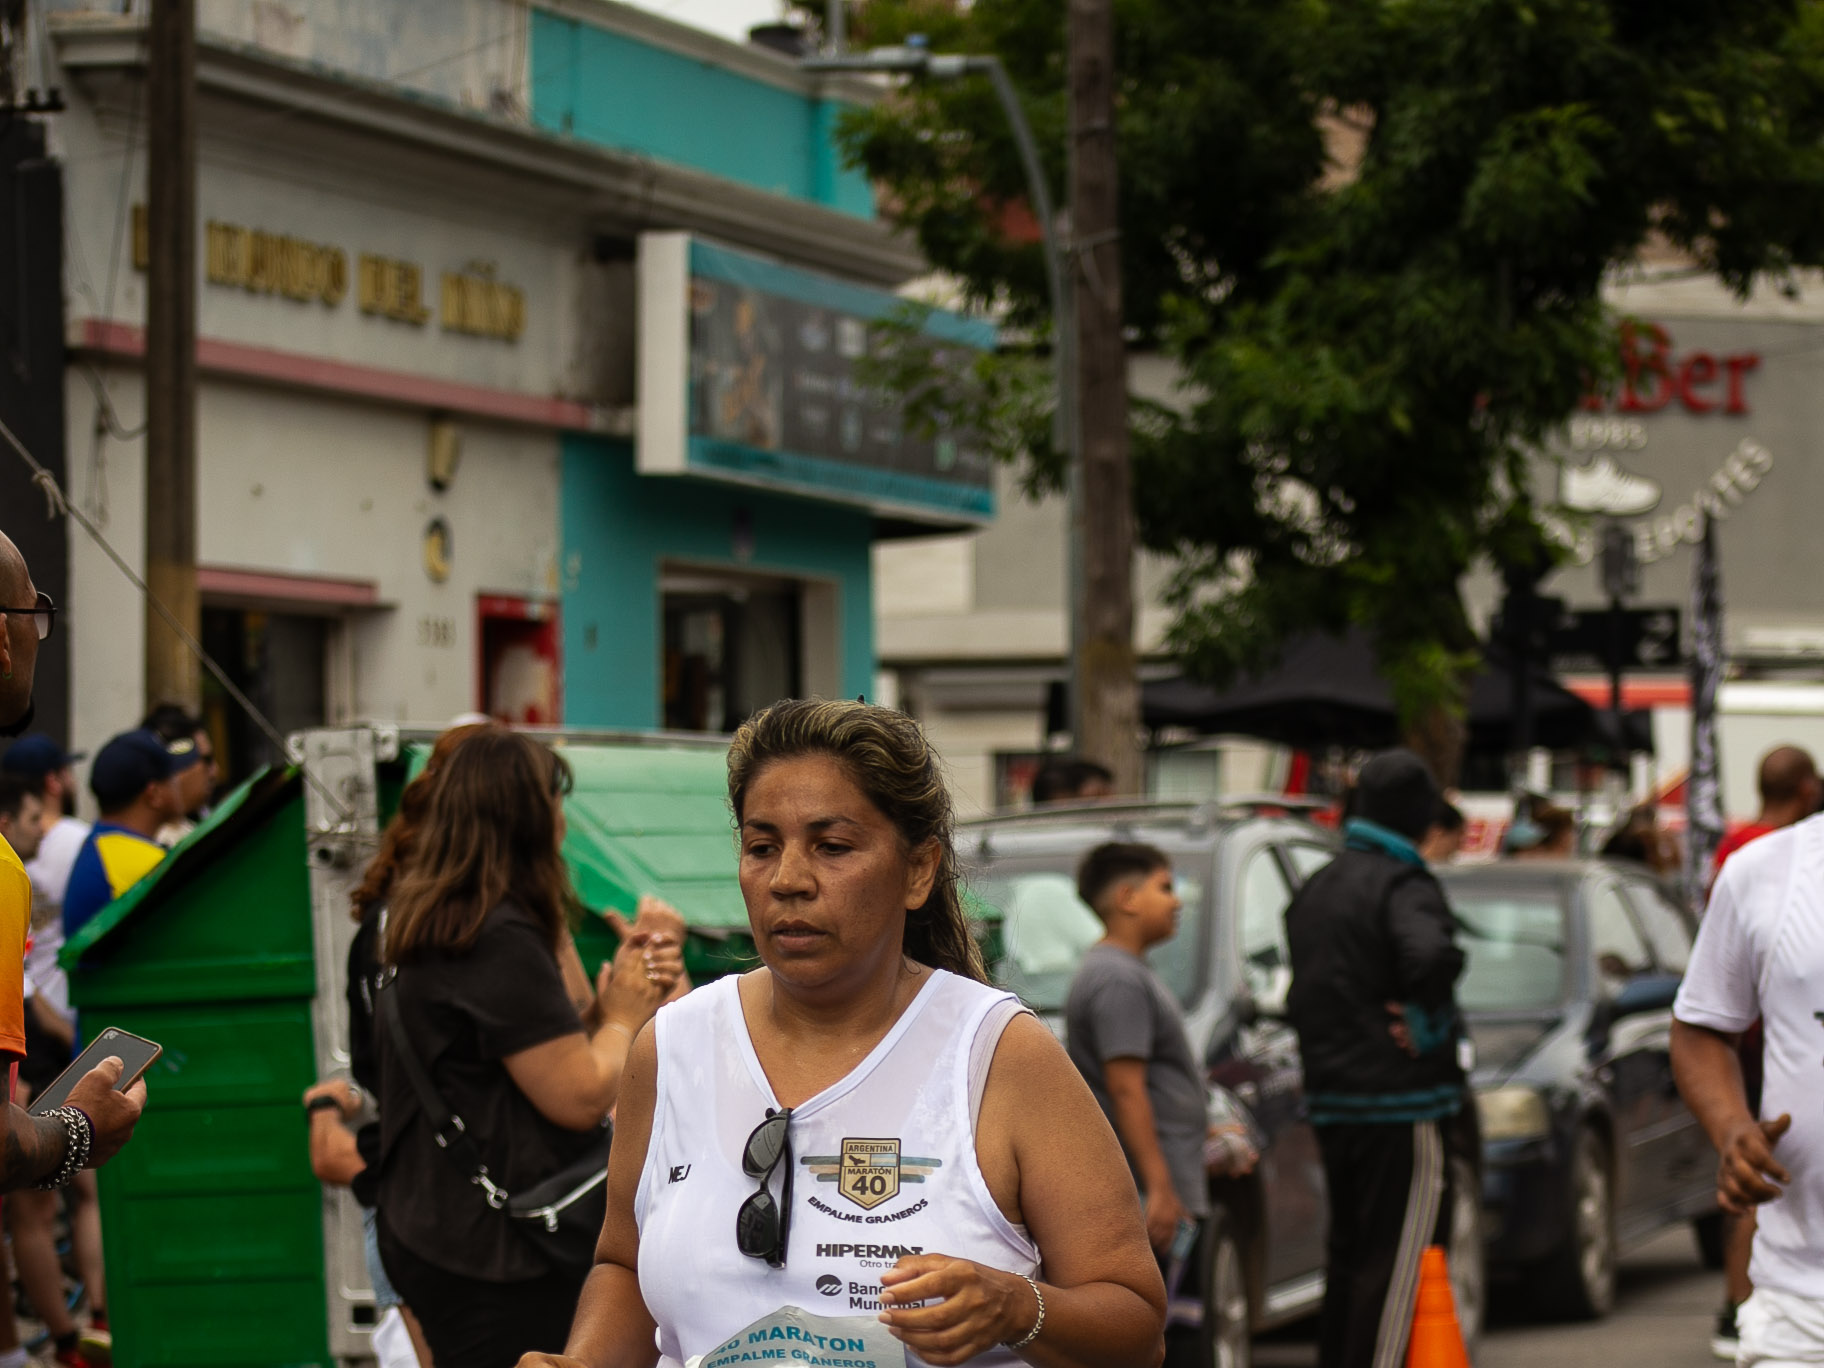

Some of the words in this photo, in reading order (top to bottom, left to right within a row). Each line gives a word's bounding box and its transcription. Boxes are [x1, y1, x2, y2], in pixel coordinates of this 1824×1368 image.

[1579, 320, 1760, 416] Ber
[848, 1144, 894, 1153] ARGENTINA
[847, 1167, 892, 1176] MARATÓN
[851, 1175, 887, 1196] 40
[807, 1196, 863, 1224] EMPALME
[865, 1198, 929, 1225] GRANEROS
[859, 1259, 883, 1268] Otro
[748, 1325, 865, 1353] MARATON
[791, 1349, 876, 1368] GRANEROS
